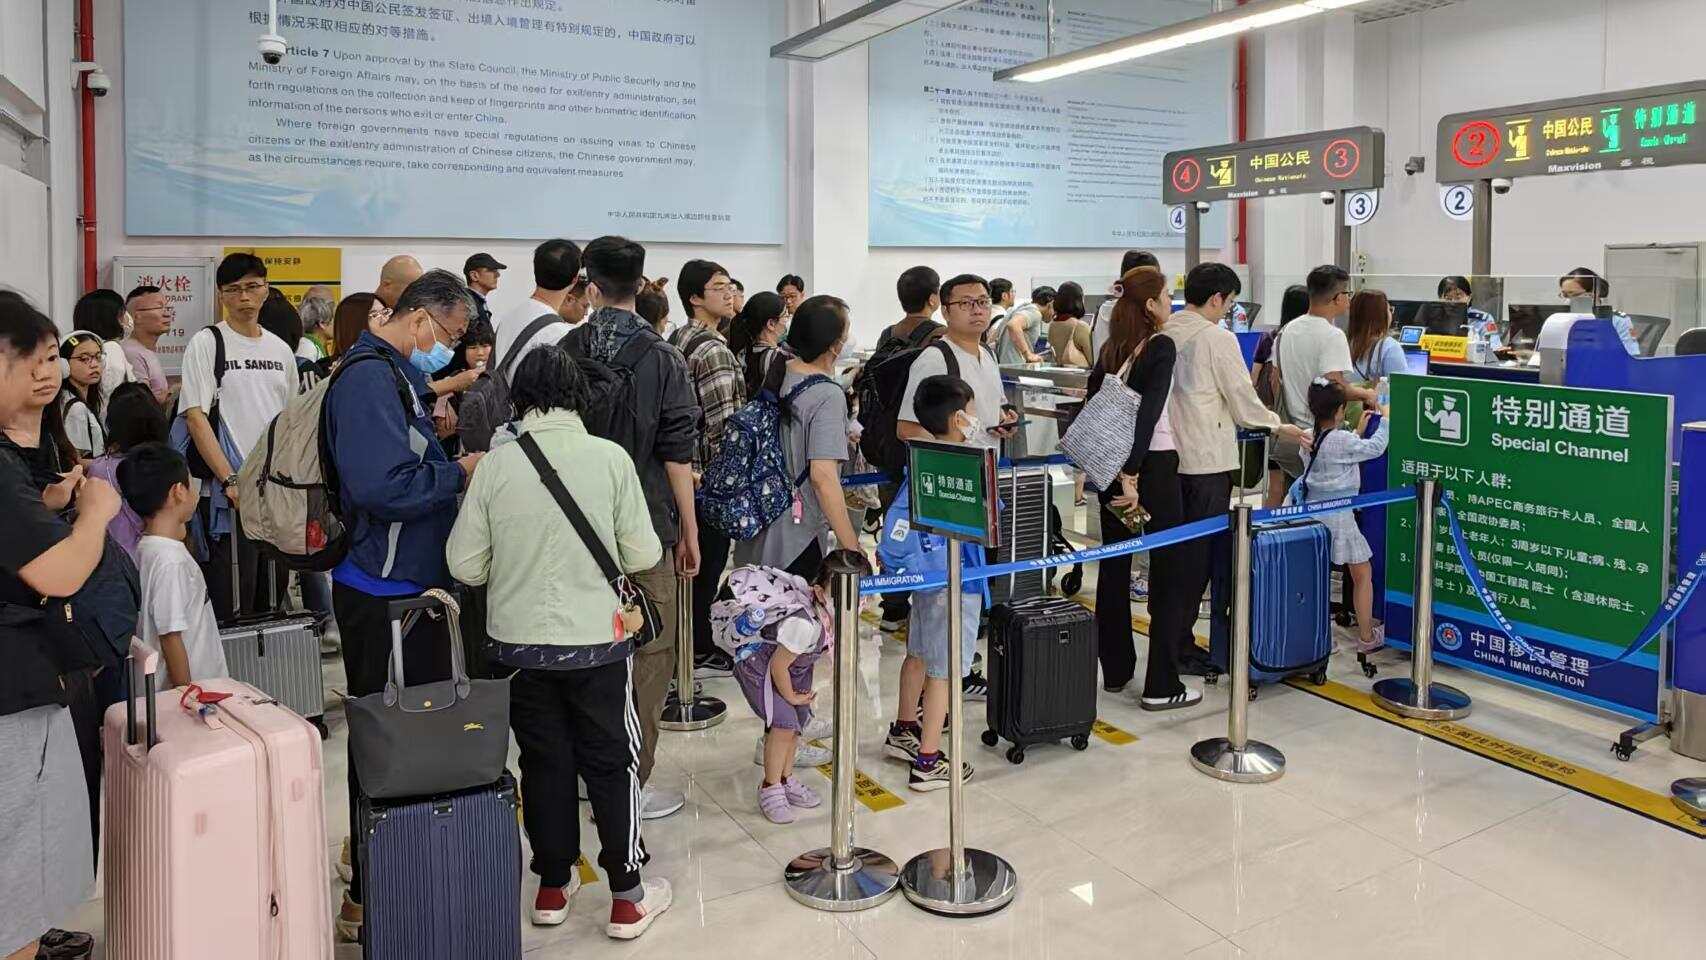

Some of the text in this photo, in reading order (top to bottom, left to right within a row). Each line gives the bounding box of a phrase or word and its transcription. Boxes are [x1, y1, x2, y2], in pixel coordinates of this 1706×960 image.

[248, 62, 292, 75] Ministry
[297, 66, 308, 74] of
[312, 67, 352, 80] Foreign
[356, 71, 390, 82] Affairs
[395, 76, 420, 85] may,
[440, 78, 456, 87] the
[460, 80, 486, 89] basis
[490, 82, 500, 90] of
[504, 83, 518, 92] the
[522, 85, 546, 94] need
[550, 86, 562, 95] for
[567, 88, 609, 100] exit/entry
[613, 92, 680, 105] administration,
[323, 49, 329, 58] 7
[334, 50, 362, 62] Upon
[365, 54, 410, 65] approval
[414, 58, 426, 68] by
[430, 59, 445, 68] the
[449, 61, 475, 71] State
[521, 66, 537, 75] the
[540, 69, 578, 81] Ministry
[580, 72, 590, 80] of
[592, 72, 620, 83] Public
[624, 75, 660, 87] Security
[664, 80, 680, 88] and
[682, 80, 696, 89] the
[248, 80, 274, 90] forth
[278, 84, 338, 95] regulations
[341, 88, 354, 96] on
[358, 88, 373, 98] the
[377, 90, 426, 101] collection
[429, 95, 448, 103] and
[450, 96, 475, 106] keep
[478, 98, 487, 106] of
[490, 98, 545, 110] fingerprints
[548, 104, 565, 112] and
[595, 106, 637, 116] biometric
[640, 109, 696, 120] identification
[248, 100, 310, 110] information
[314, 103, 323, 111] of
[326, 104, 342, 112] the
[346, 108, 387, 116] persons
[390, 110, 410, 118] who
[414, 110, 432, 118] exit
[447, 112, 472, 120] enter
[248, 136, 290, 145] citizens
[309, 137, 326, 147] the
[330, 139, 380, 152] exit/entry
[383, 143, 456, 154] administration
[459, 146, 468, 154] of
[472, 146, 512, 156] Chinese
[516, 149, 556, 159] citizens,
[560, 152, 573, 160] the
[578, 152, 615, 162] Chinese
[618, 154, 671, 164] government
[276, 118, 696, 151] Where foreign governments have special regulations on issuing visas to Chinese
[1468, 131, 1485, 155] 2
[1543, 117, 1593, 139] 中国公民
[248, 153, 624, 177] as the circumstances require, take corresponding and equivalent measures
[1181, 148, 1348, 183] 4 中国公民 3
[1548, 162, 1602, 172] Maxvision
[1356, 198, 1366, 214] 3
[1454, 192, 1464, 210] 2
[1175, 211, 1182, 225] 4
[137, 276, 191, 292] 消火栓
[244, 360, 284, 372] SANDER
[1492, 394, 1631, 439] 特别通道
[1492, 432, 1629, 464] Special Channel
[1402, 459, 1512, 490] 适用于以下人群:
[874, 574, 924, 586] IMMIGRATION
[1470, 630, 1589, 676] 中国移民管理
[1474, 650, 1506, 666] CHINA
[1510, 661, 1585, 688] IMMIGRATION
